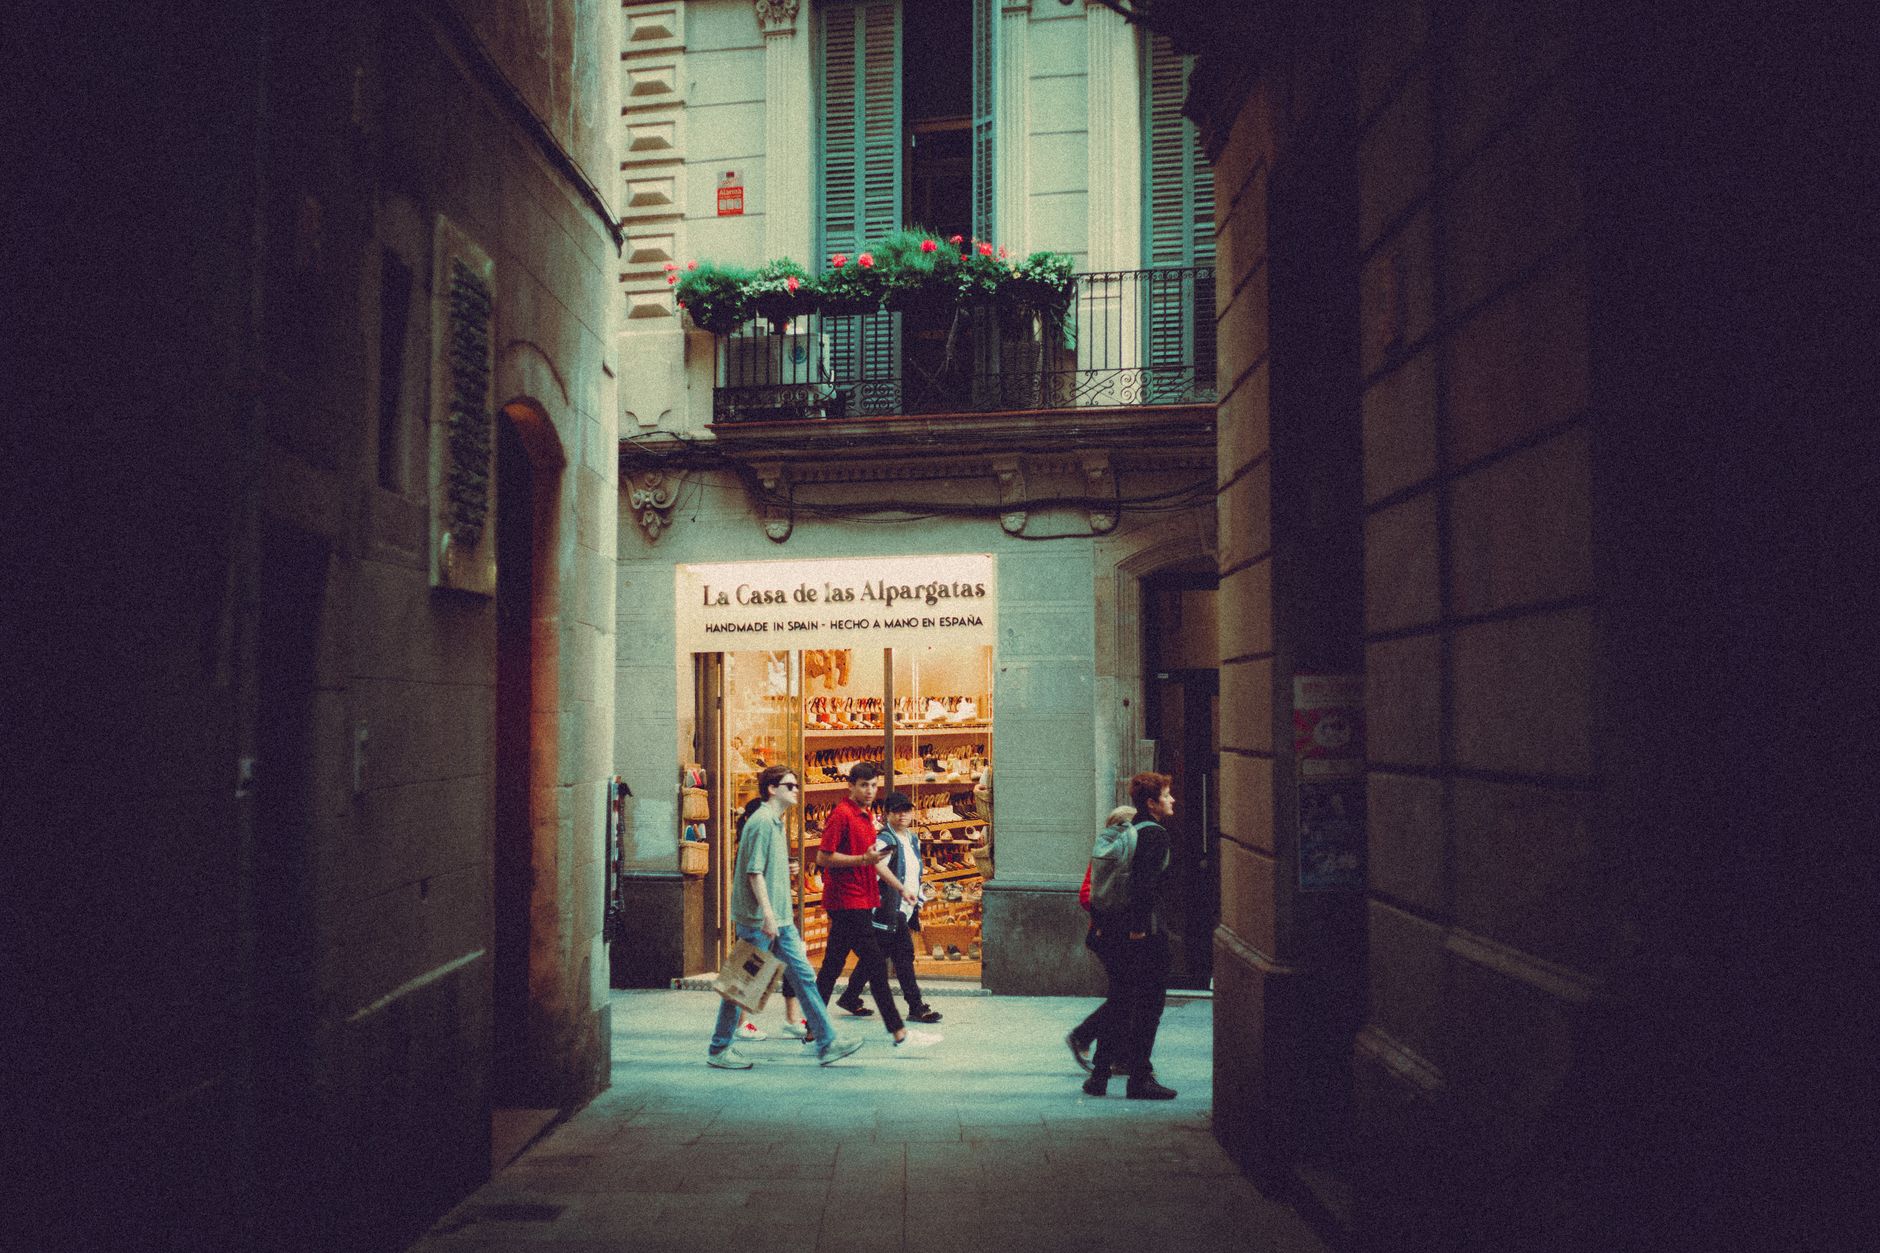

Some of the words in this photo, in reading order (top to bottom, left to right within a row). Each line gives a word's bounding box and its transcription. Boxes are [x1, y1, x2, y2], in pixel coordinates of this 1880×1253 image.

[703, 584, 730, 607] La
[735, 583, 787, 606] Casa
[793, 582, 818, 604] de
[823, 581, 856, 603] las
[859, 579, 987, 607] Alpargatas
[705, 621, 769, 633] HANDMADE
[772, 621, 785, 632] IN
[787, 620, 819, 632] SPAIN
[829, 618, 870, 631] HECHO
[872, 618, 882, 629] A
[883, 616, 920, 629] MANO
[921, 617, 936, 628] EN
[939, 614, 984, 628] ESPAÑA
